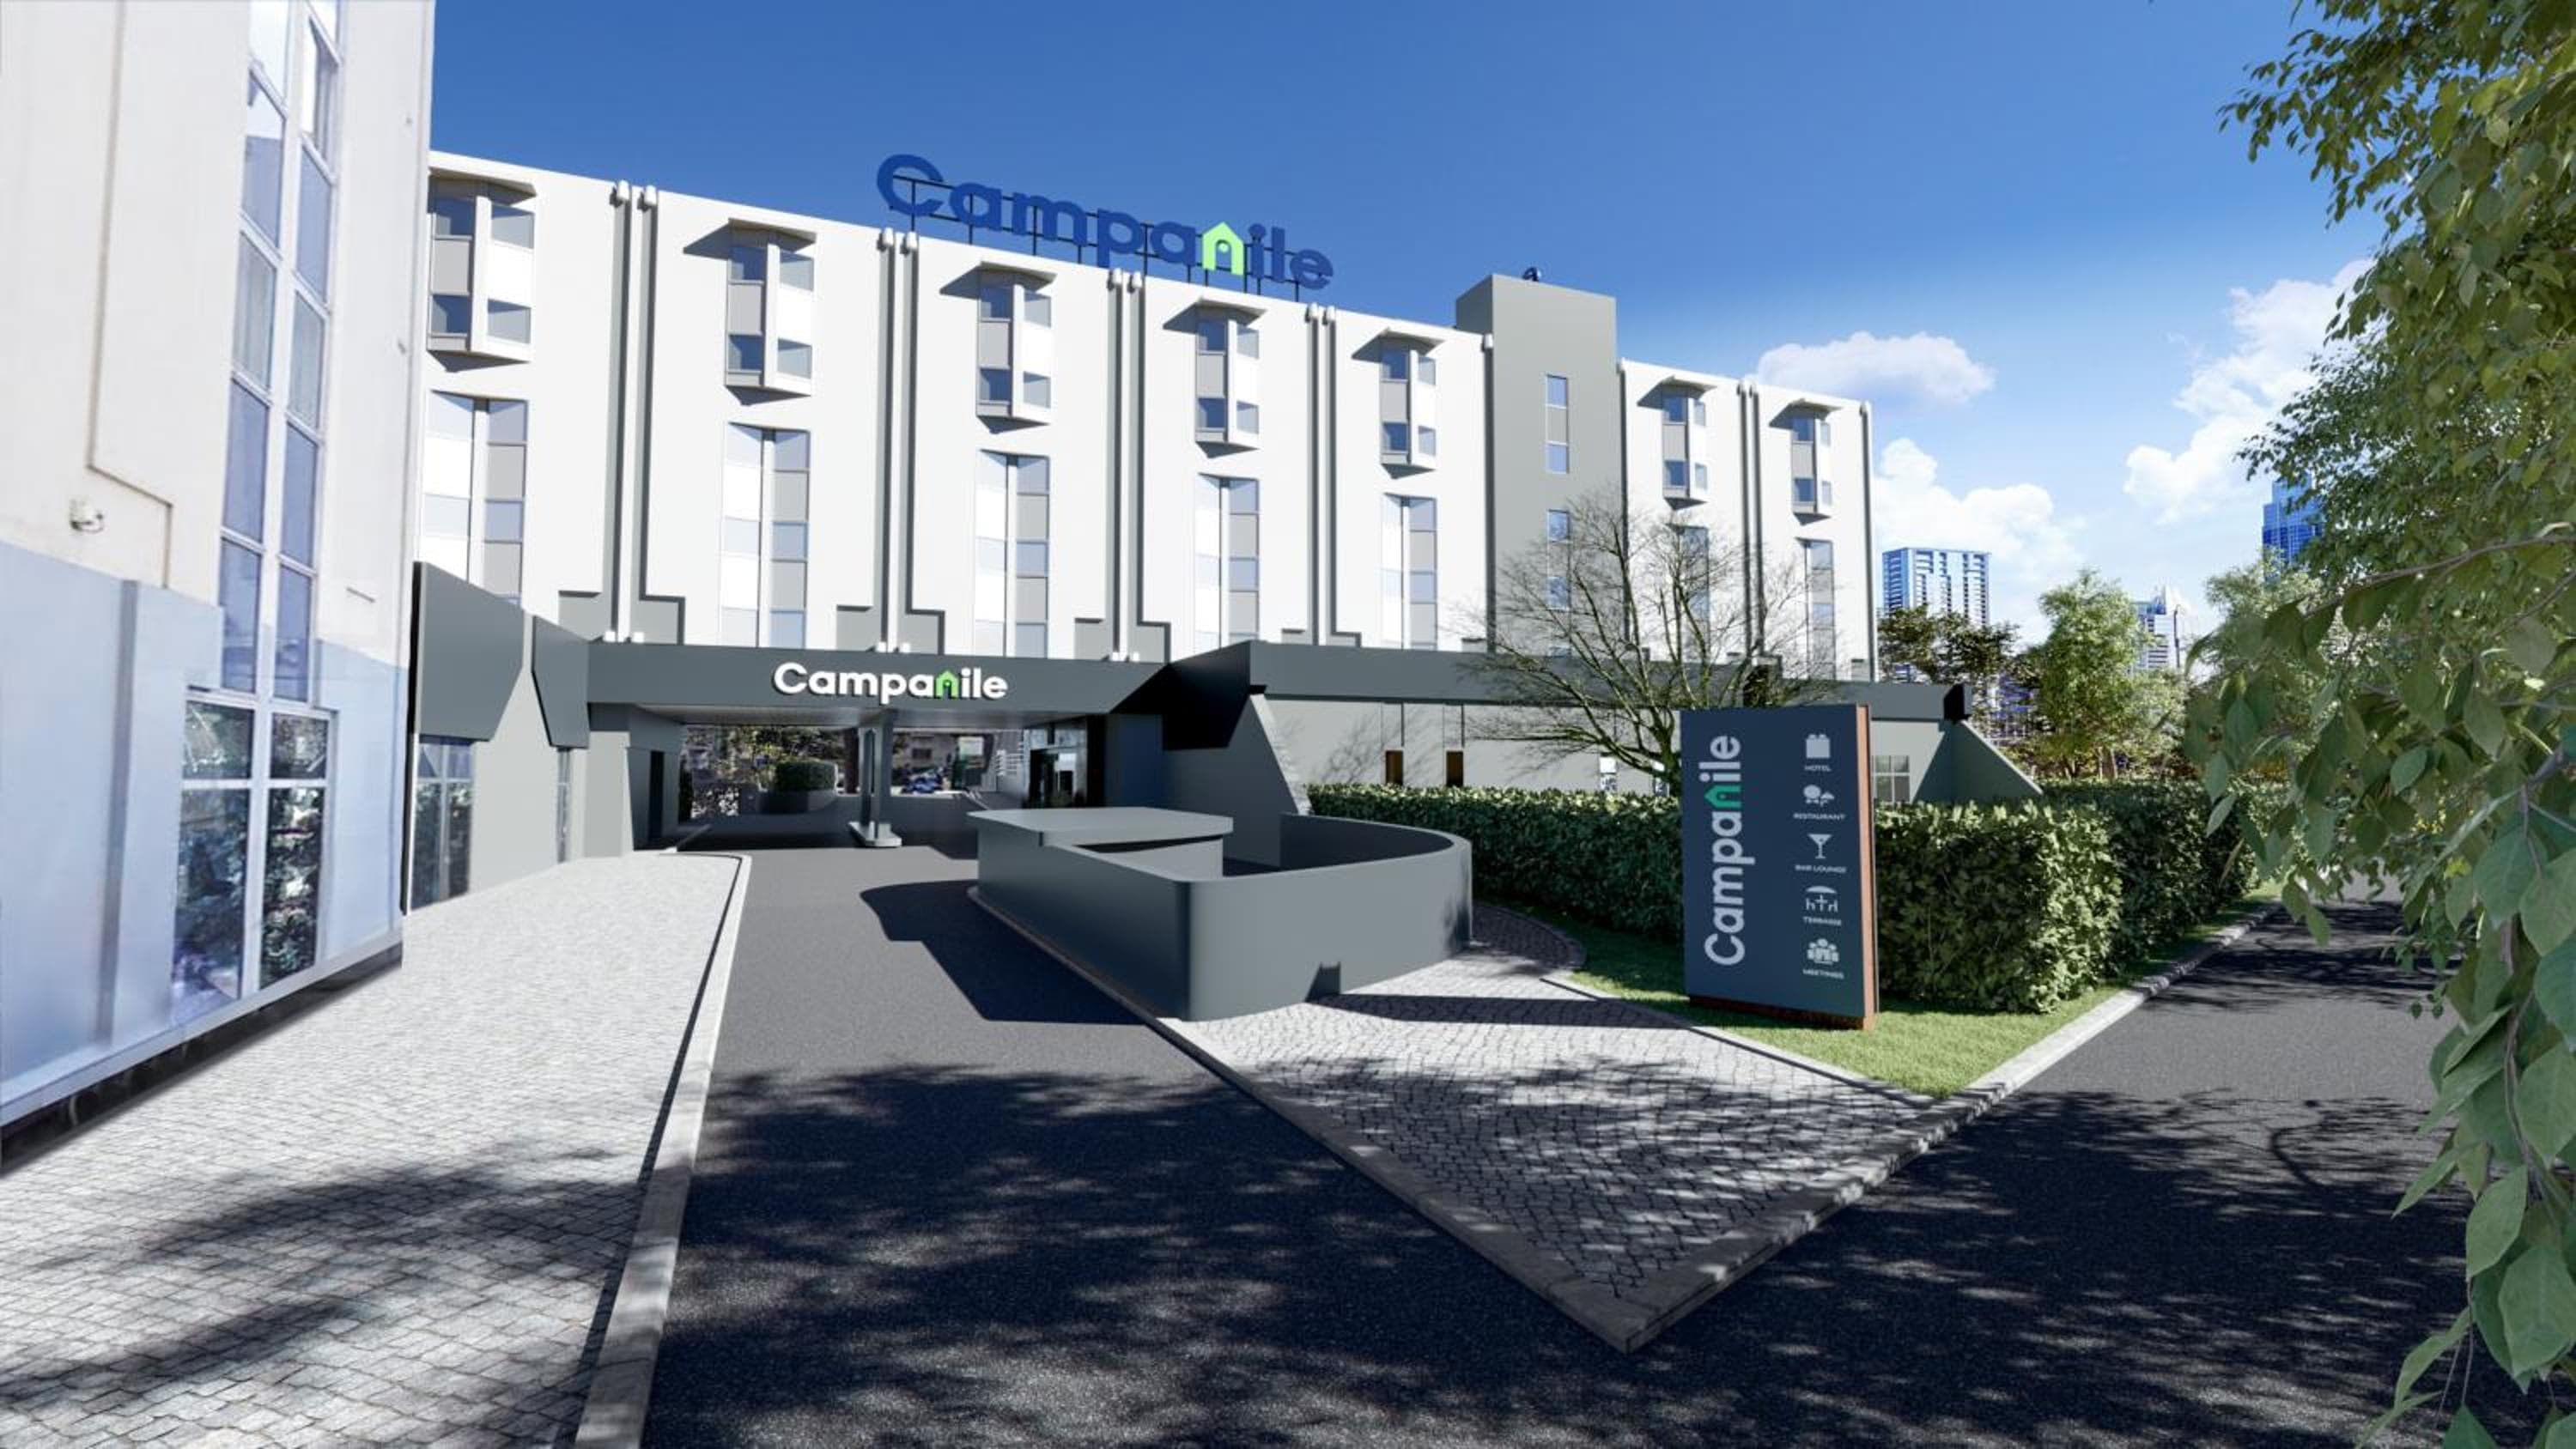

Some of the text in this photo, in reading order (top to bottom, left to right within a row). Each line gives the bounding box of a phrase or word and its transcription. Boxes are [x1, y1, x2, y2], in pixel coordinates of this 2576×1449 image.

[876, 154, 1334, 290] Campanile
[773, 662, 1009, 705] Campanile
[1793, 812, 1845, 821] RESTAURANT
[1698, 735, 1756, 966] Campanile
[1813, 864, 1846, 874] LOUNGE
[1802, 968, 1844, 979] MEETINGS
